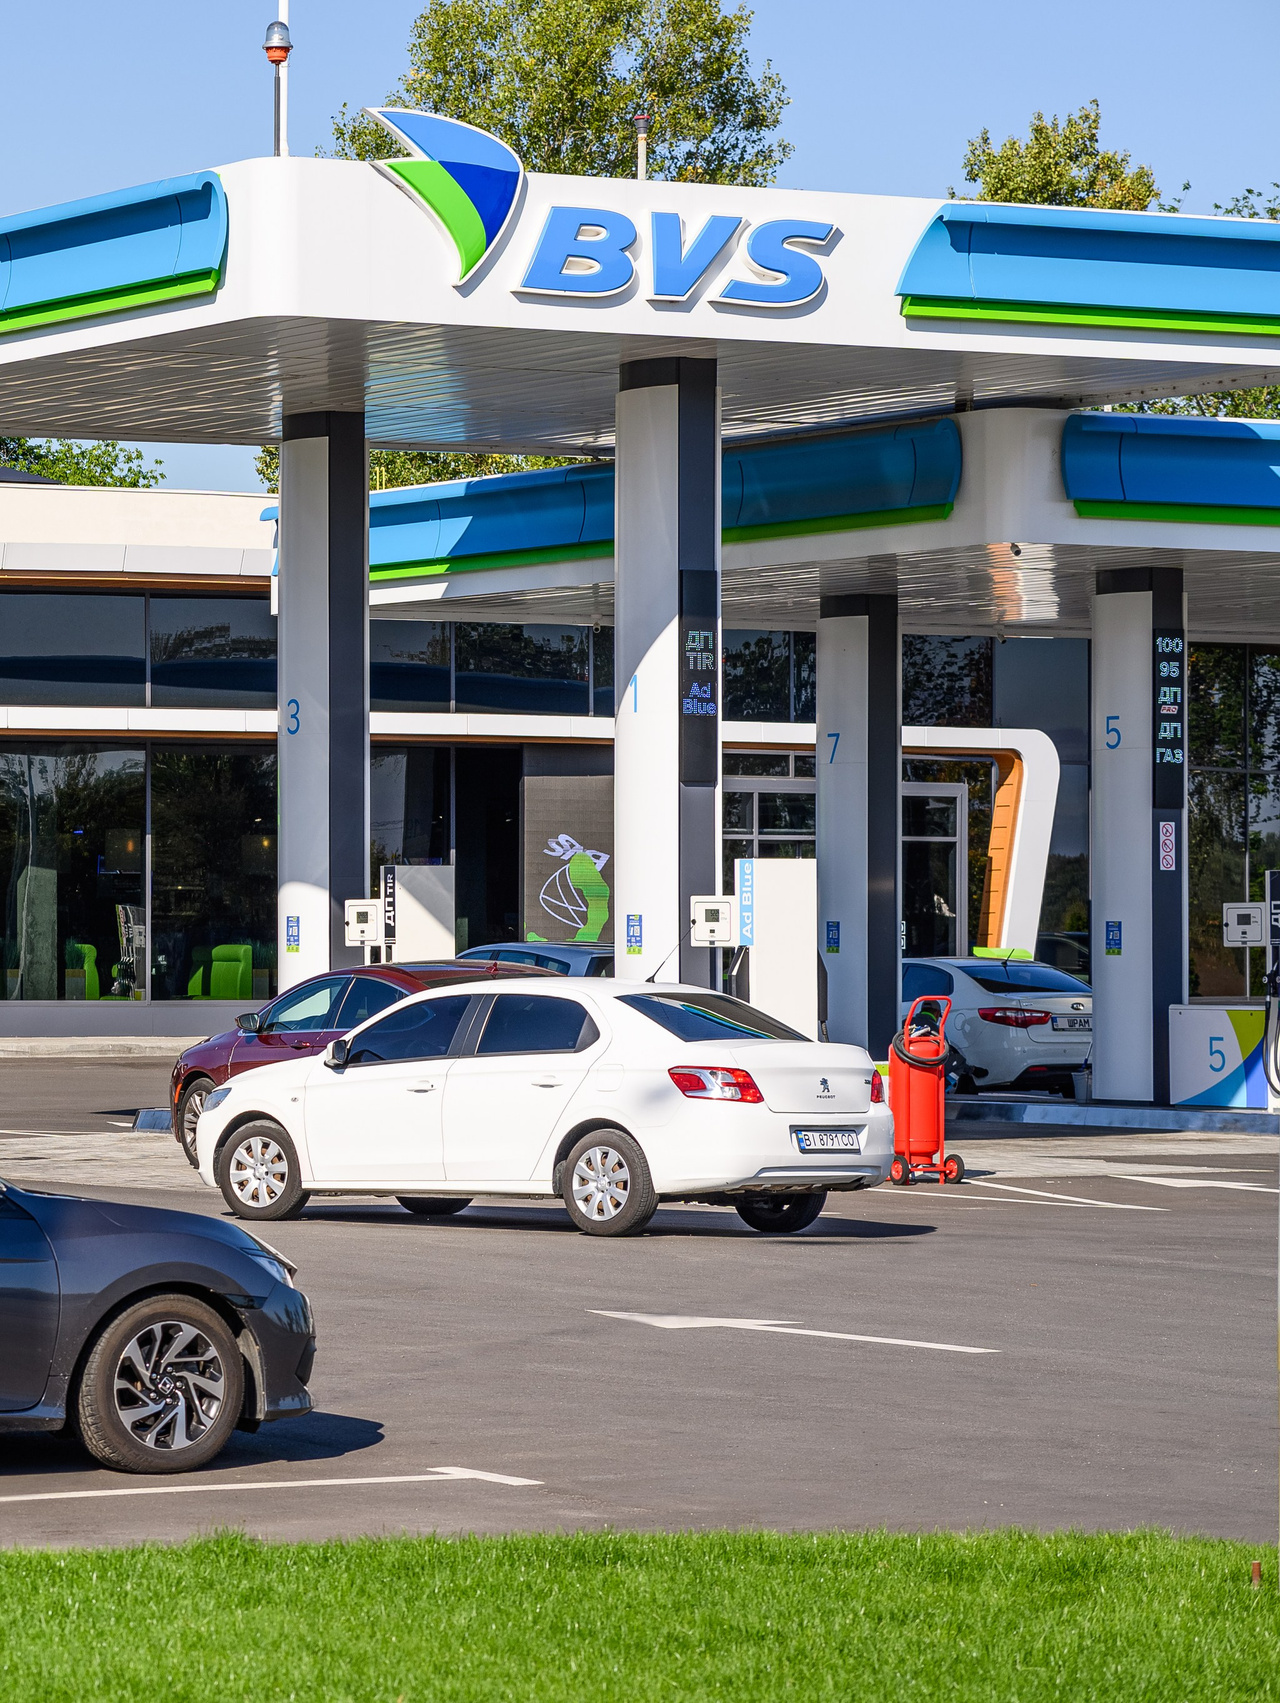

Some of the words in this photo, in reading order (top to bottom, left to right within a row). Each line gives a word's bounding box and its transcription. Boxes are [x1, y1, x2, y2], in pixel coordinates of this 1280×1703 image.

[513, 206, 841, 308] BVS
[685, 631, 713, 650] ДП
[1156, 637, 1183, 653] 100
[686, 652, 714, 669] TIR
[1159, 661, 1180, 677] 95
[629, 674, 638, 713] 1
[688, 682, 711, 698] Ad
[1158, 687, 1181, 704] ДП
[682, 698, 717, 714] Blue
[287, 698, 300, 735] 3
[1105, 715, 1122, 750] 5
[1158, 722, 1181, 739] ДП
[827, 732, 840, 764] 7
[1156, 747, 1184, 763] ГАЗ
[742, 862, 753, 906] Blue
[385, 897, 395, 927] ДП
[742, 911, 753, 939] Ad
[1209, 1036, 1226, 1073] 5
[803, 1133, 817, 1147] BI
[818, 1133, 841, 1147] 8791
[840, 1133, 855, 1147] CO
